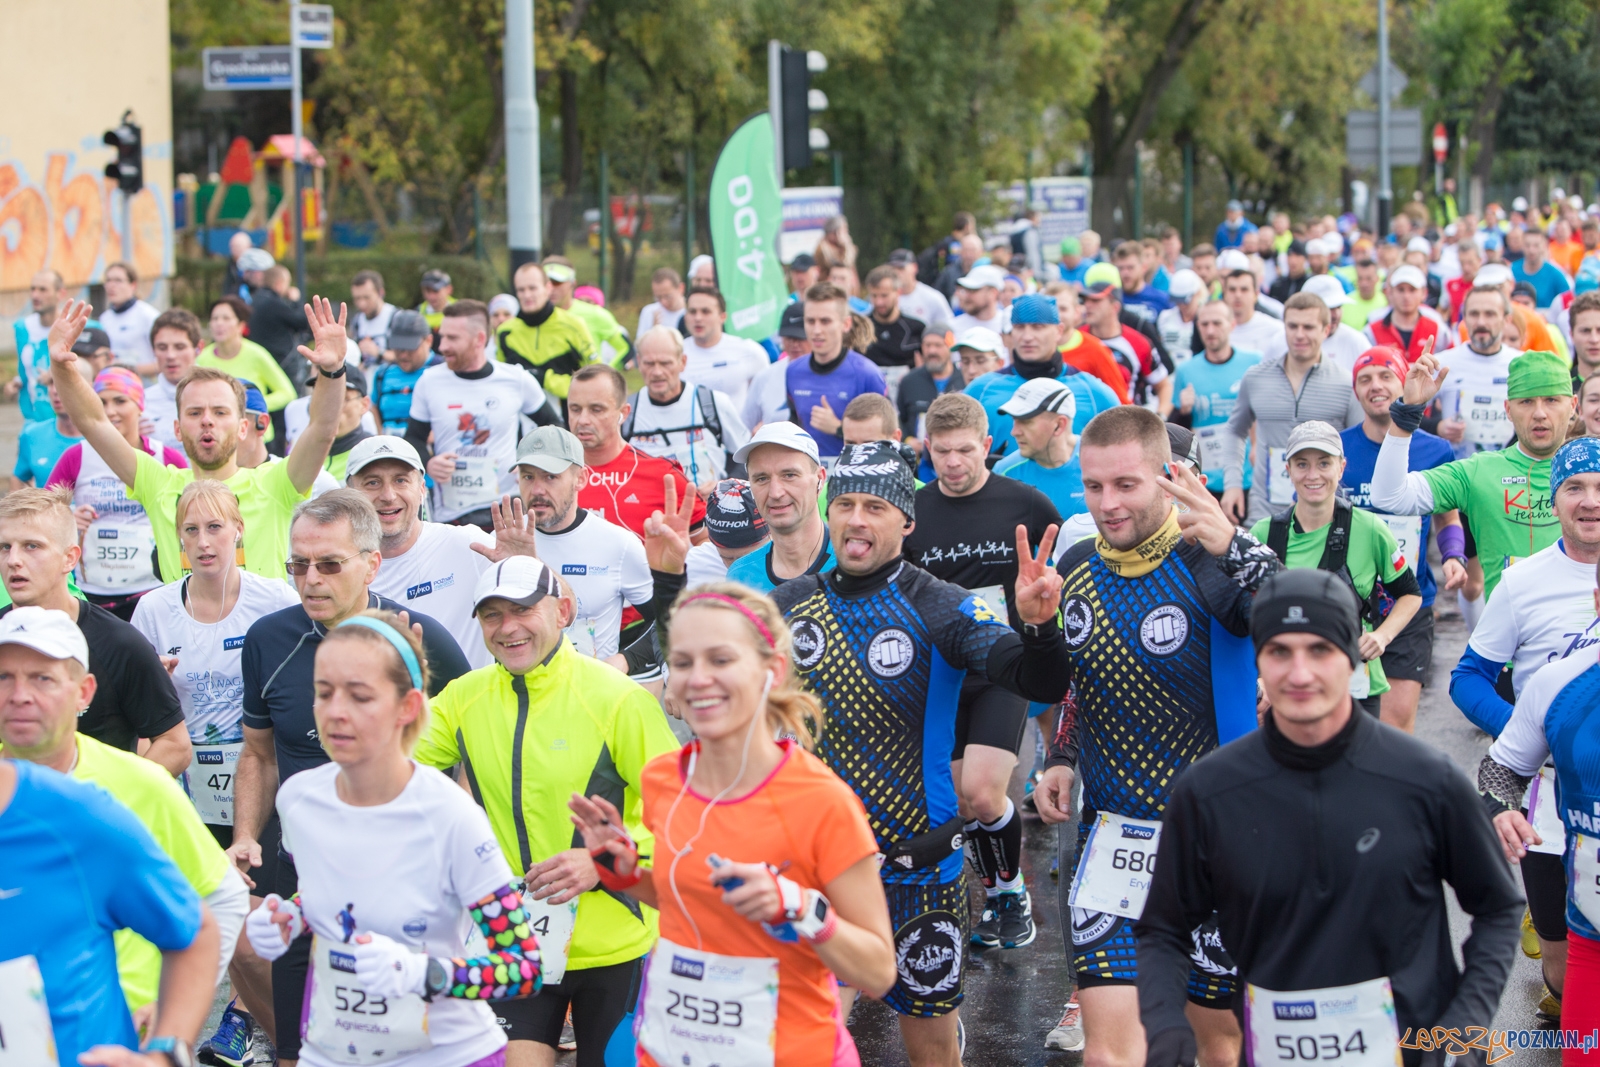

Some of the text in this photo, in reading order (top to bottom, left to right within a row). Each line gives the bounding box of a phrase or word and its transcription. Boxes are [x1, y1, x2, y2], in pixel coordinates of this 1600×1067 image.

[728, 174, 765, 281] 4:00
[705, 513, 749, 528] MARATHON
[97, 546, 139, 560] 3537
[207, 773, 232, 791] 47
[1082, 921, 1110, 942] EIGHTY
[335, 985, 388, 1016] 523
[666, 988, 743, 1027] 2533
[335, 1018, 390, 1035] Agnieszka
[670, 1023, 736, 1046] Aleksandra
[1275, 1028, 1368, 1060] 5034
